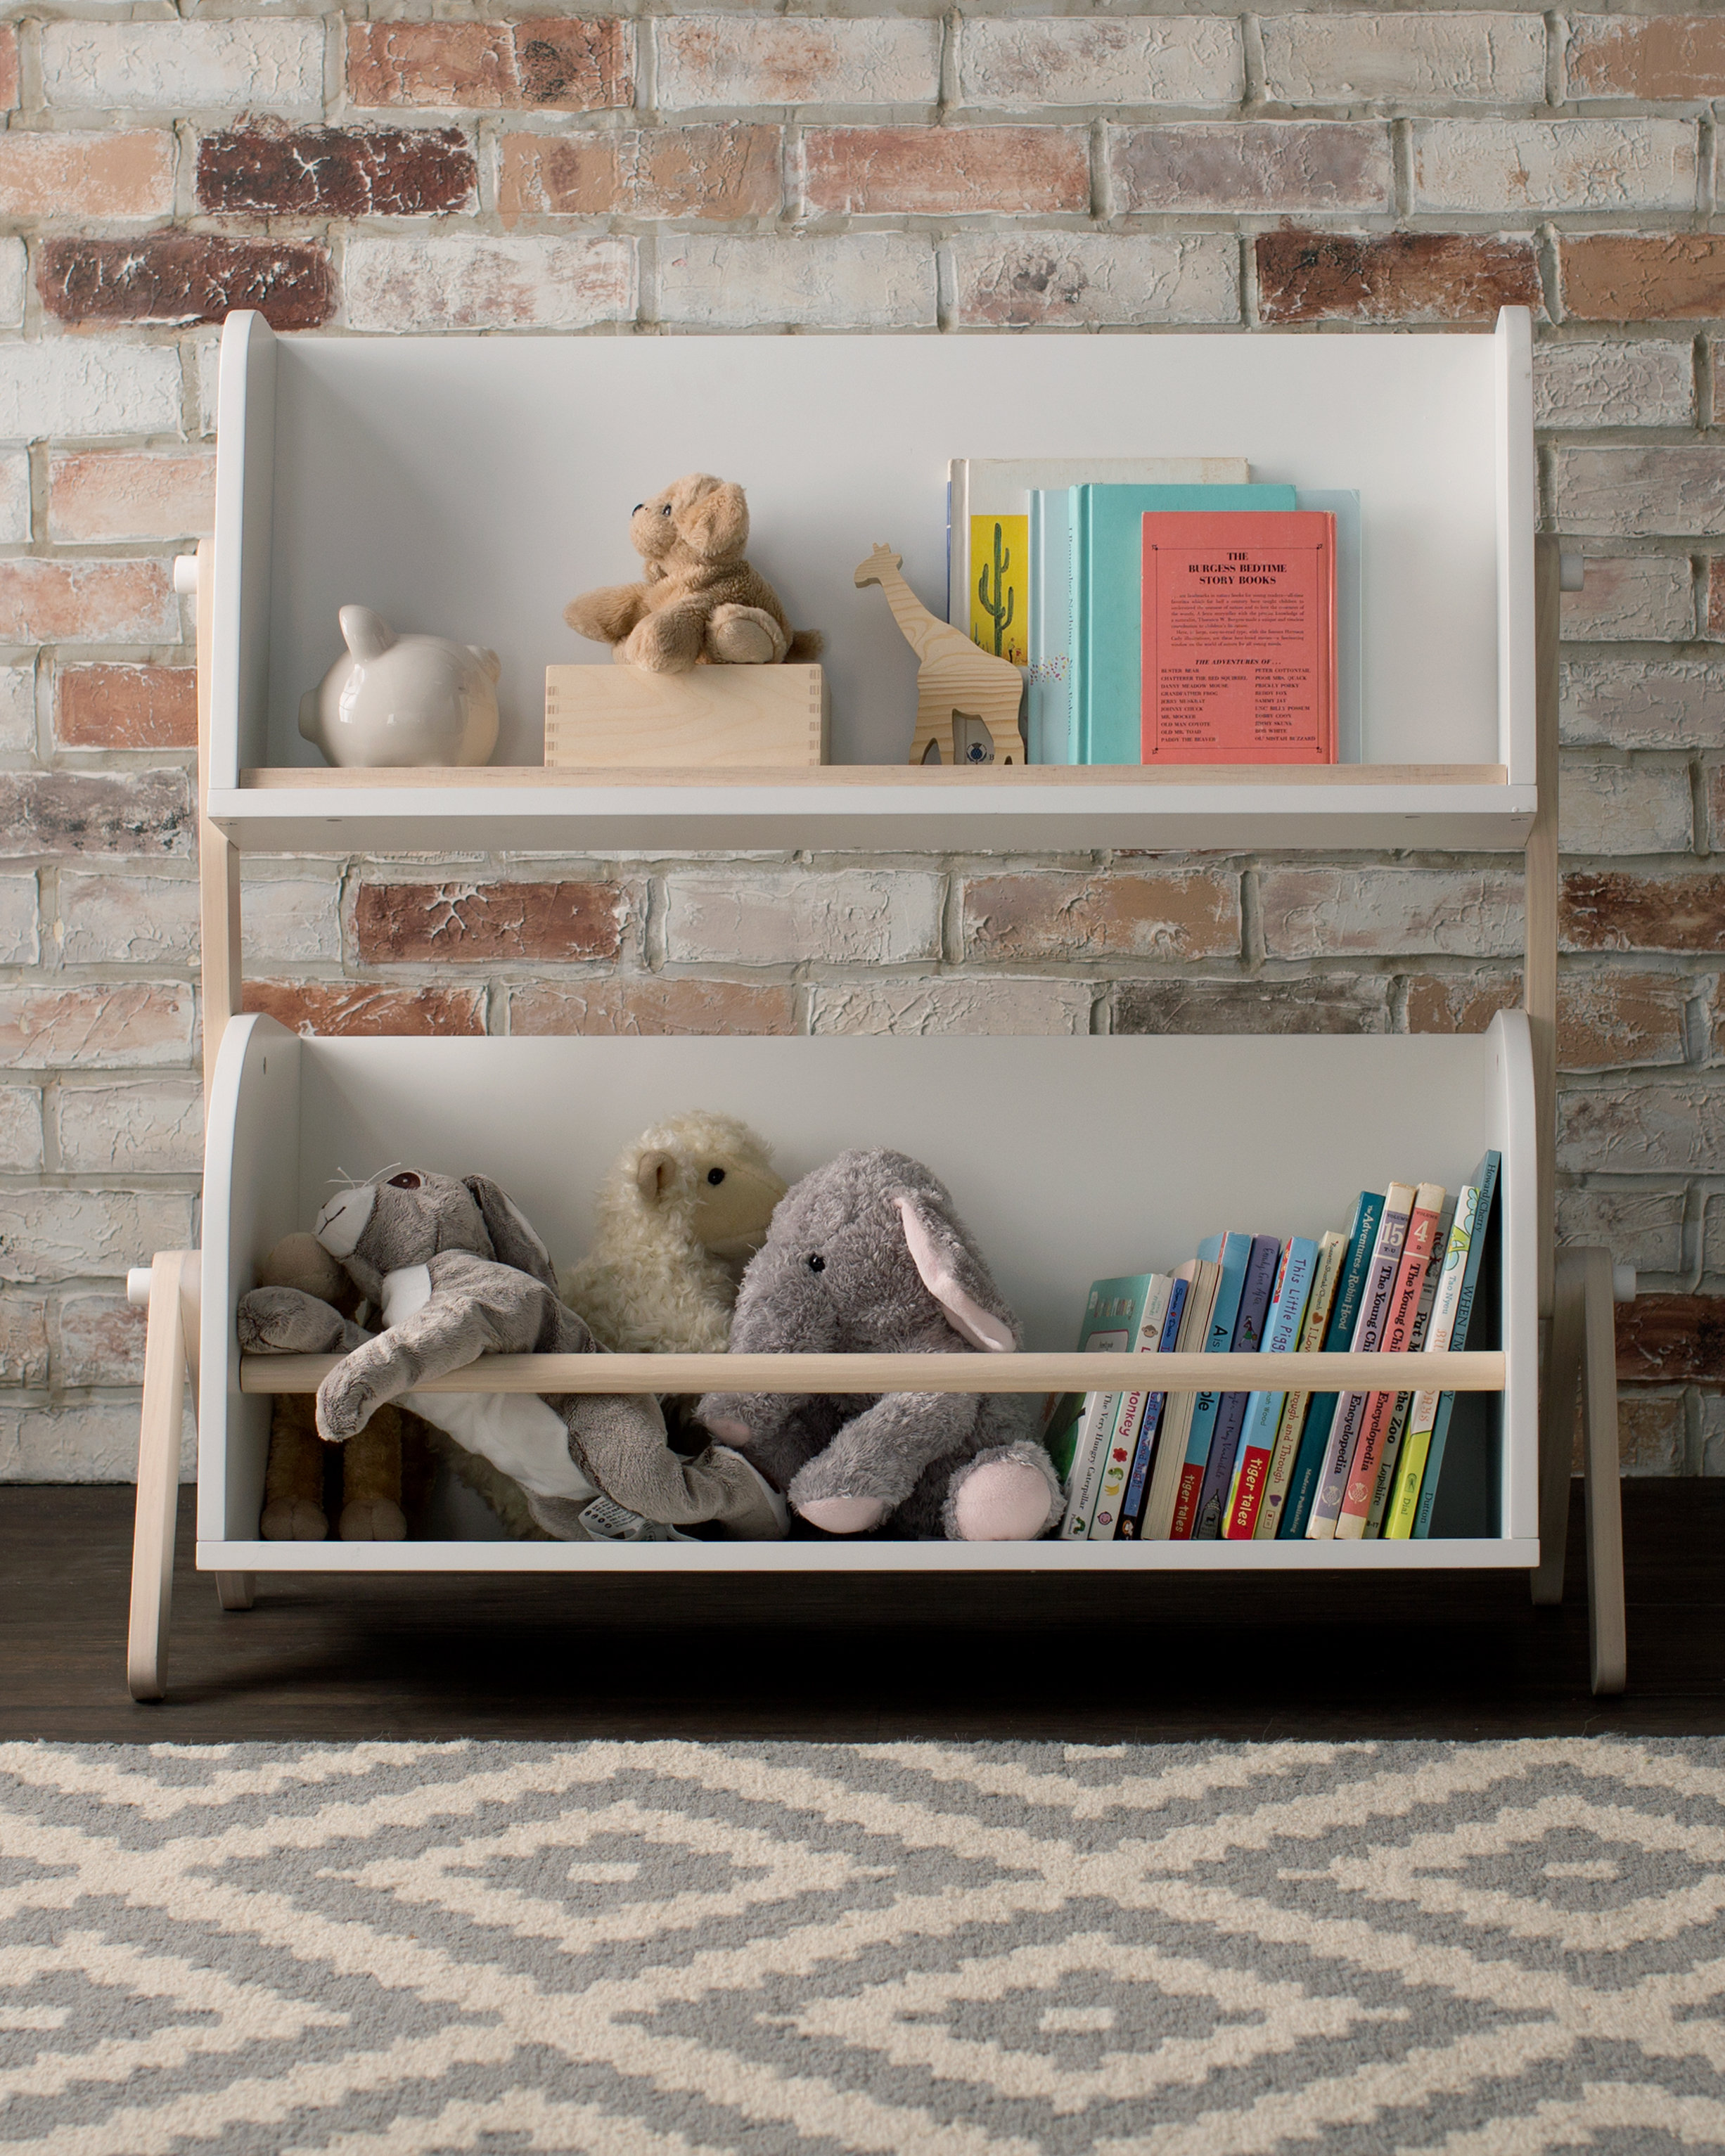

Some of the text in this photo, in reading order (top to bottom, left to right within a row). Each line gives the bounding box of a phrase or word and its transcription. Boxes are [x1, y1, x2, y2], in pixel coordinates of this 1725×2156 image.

[1189, 564, 1287, 573] BURGESS BEDTIME
[1227, 552, 1248, 560] THE
[1199, 576, 1276, 585] STORY BOOKS
[1474, 1163, 1496, 1233] Howard/Cherry
[1387, 1213, 1408, 1222] VOLUME
[1416, 1211, 1438, 1220] VOLUME
[1353, 1213, 1374, 1271] Adventures
[1381, 1221, 1405, 1247] 15
[1413, 1220, 1429, 1243] 4
[1405, 1263, 1421, 1287] The
[1445, 1276, 1457, 1296] Tao
[1344, 1274, 1360, 1304] Robin
[1271, 1259, 1306, 1352] This Little Pigg
[1338, 1303, 1353, 1331] Hood
[1394, 1288, 1415, 1326] Young
[1456, 1285, 1474, 1328] WHEN
[1213, 1325, 1229, 1336] A
[1412, 1310, 1428, 1339] Put
[1212, 1338, 1223, 1348] is
[1305, 1334, 1317, 1352] Lov
[1407, 1340, 1420, 1352] M
[1434, 1328, 1447, 1349] BU
[1334, 1266, 1392, 1475] The Young Chi Encyclopedia
[1261, 1406, 1271, 1426] Wood
[1288, 1391, 1301, 1421] rough
[1283, 1423, 1294, 1442] and
[1361, 1392, 1389, 1472] Encyclopedia
[1386, 1417, 1403, 1444] Zoo
[1079, 1393, 1113, 1510] The Very Hungry Caterpillar
[1273, 1445, 1292, 1484] Through
[1237, 1457, 1263, 1527] tiger tales
[1373, 1462, 1392, 1507] Lopshire
[1175, 1474, 1195, 1533] tiger tales
[1290, 1467, 1312, 1534] Modern Publishing
[1400, 1497, 1411, 1516] Dial
[1420, 1491, 1434, 1523] Dutton
